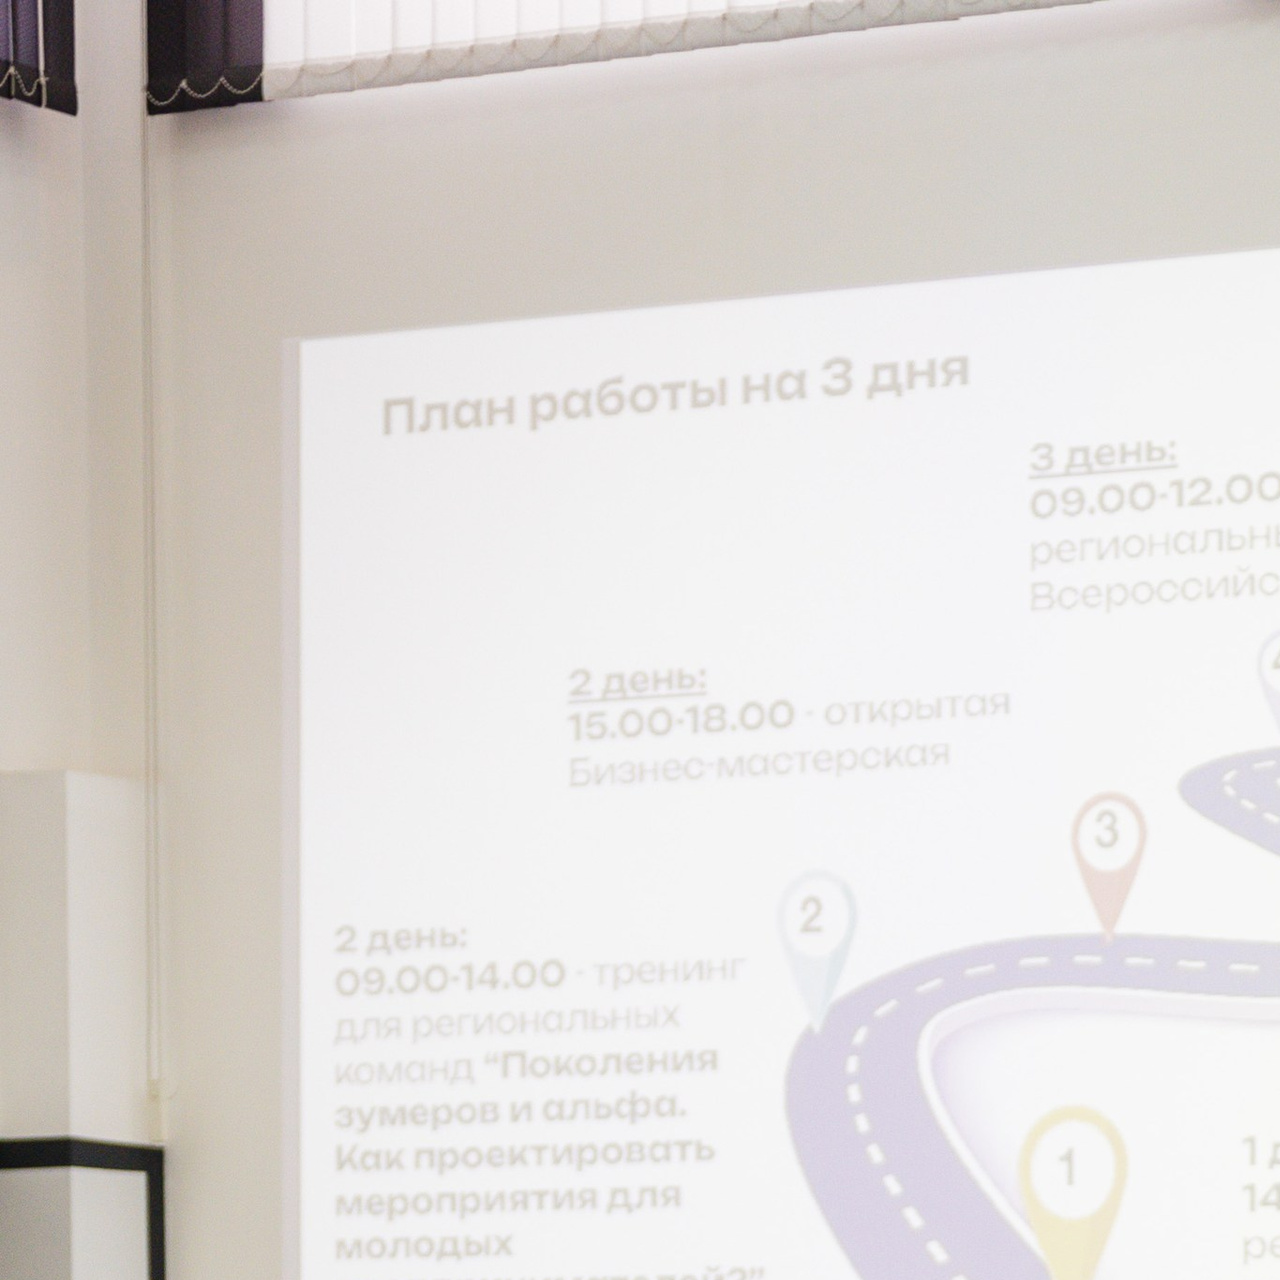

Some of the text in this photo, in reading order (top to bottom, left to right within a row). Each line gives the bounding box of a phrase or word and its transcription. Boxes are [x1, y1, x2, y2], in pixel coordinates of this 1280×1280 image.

[382, 355, 971, 436] План работы на 3 дня
[1029, 437, 1178, 474] 3 день:
[568, 665, 708, 700] 2 день:
[567, 699, 796, 743] 15.00-18.00
[823, 691, 1012, 731] открытая
[567, 738, 951, 788] Бизнес-мастерская
[1095, 809, 1119, 848] 3
[799, 895, 825, 934] 2
[333, 922, 468, 956] 2 день:
[334, 958, 567, 997] 09.00-14.00
[593, 956, 747, 990] тренинг
[333, 1003, 682, 1047] для региональных
[334, 1053, 477, 1087] команд
[334, 1088, 688, 1134] зумеров и альфа.
[334, 1137, 716, 1176] Как проектировать
[1056, 1145, 1078, 1188] 1
[1241, 1135, 1258, 1167] 1
[334, 1184, 683, 1223] мероприятия для
[334, 1232, 515, 1265] молодых
